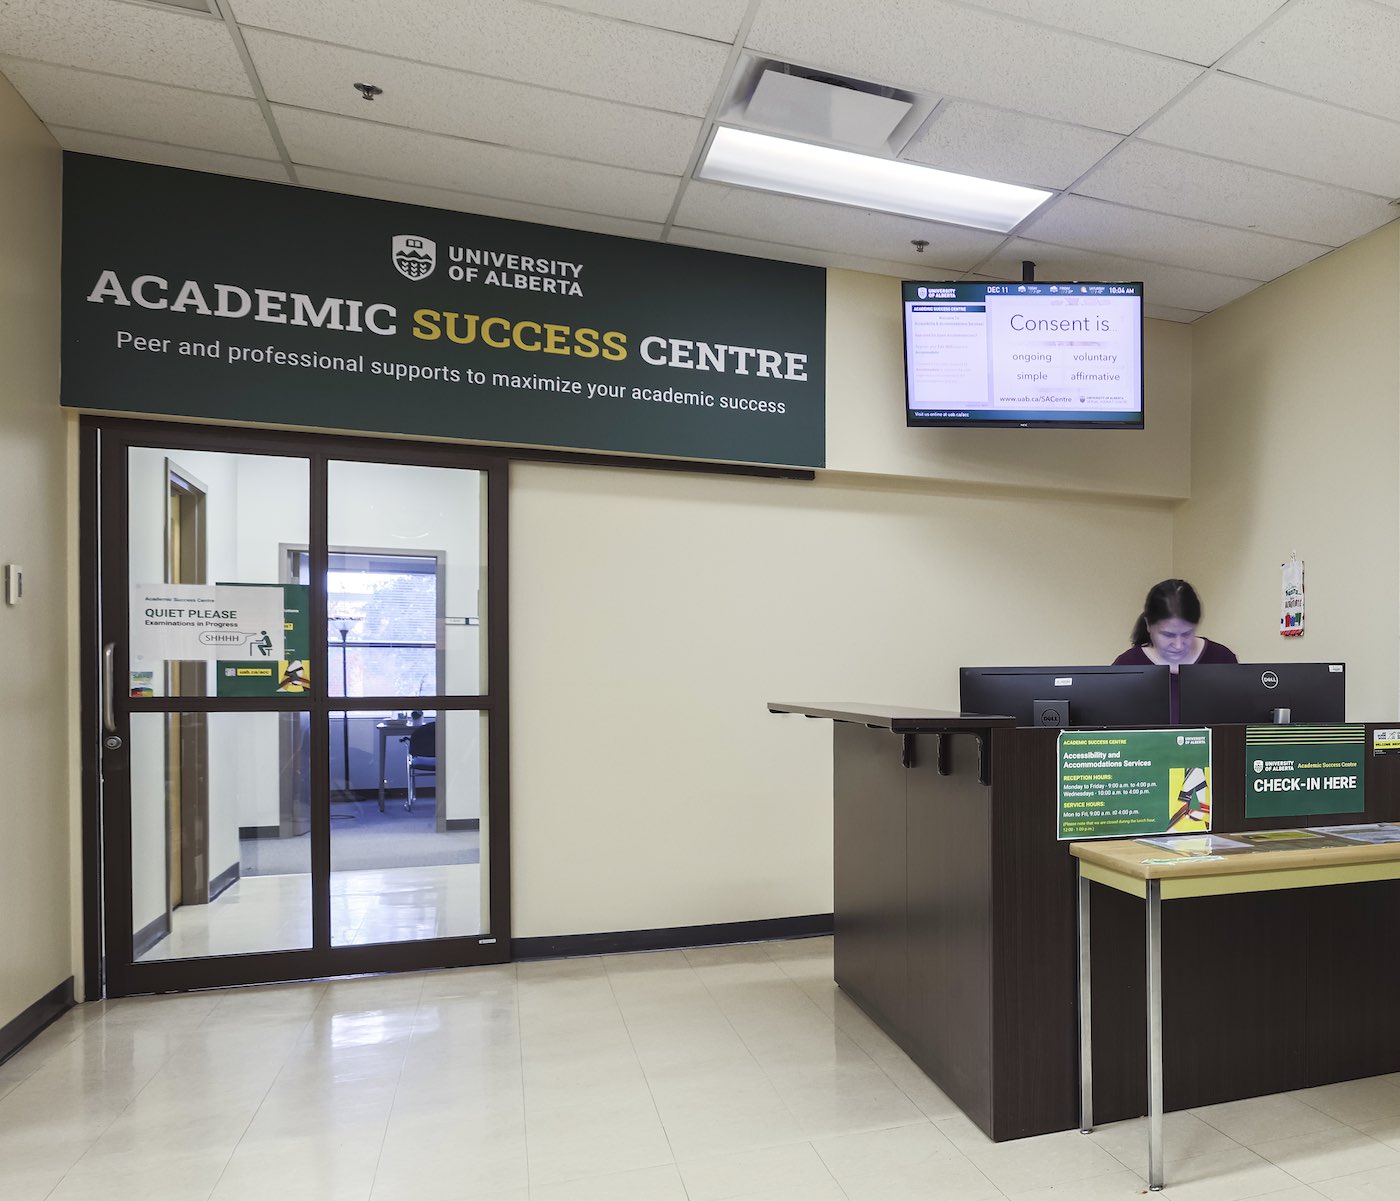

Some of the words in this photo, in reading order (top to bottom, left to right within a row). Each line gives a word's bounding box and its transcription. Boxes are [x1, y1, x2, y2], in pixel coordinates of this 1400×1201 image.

[448, 245, 584, 278] UNIVERSITY
[448, 265, 479, 285] OF
[484, 268, 584, 296] ALBERTA
[87, 269, 398, 336] ACADEMIC
[412, 308, 628, 362] SUCCESS
[639, 334, 808, 382] CENTRE
[1010, 314, 1090, 331] Consent
[1012, 352, 1052, 363] ongoing
[1073, 352, 1117, 363] voluntary
[116, 330, 172, 358] Peer
[178, 336, 220, 360] and
[228, 341, 364, 376] professional
[370, 352, 460, 386] supports
[466, 368, 486, 386] to
[492, 370, 582, 395] maximize
[588, 382, 627, 402] your
[632, 382, 714, 408] academic
[720, 393, 786, 416] success
[1017, 372, 1048, 382] simple
[1071, 372, 1120, 381] affirmative
[145, 608, 185, 618] QUIET
[188, 610, 237, 619] PLEASE
[1254, 778, 1320, 792] CHECK-IN
[1324, 776, 1357, 789] HERE
